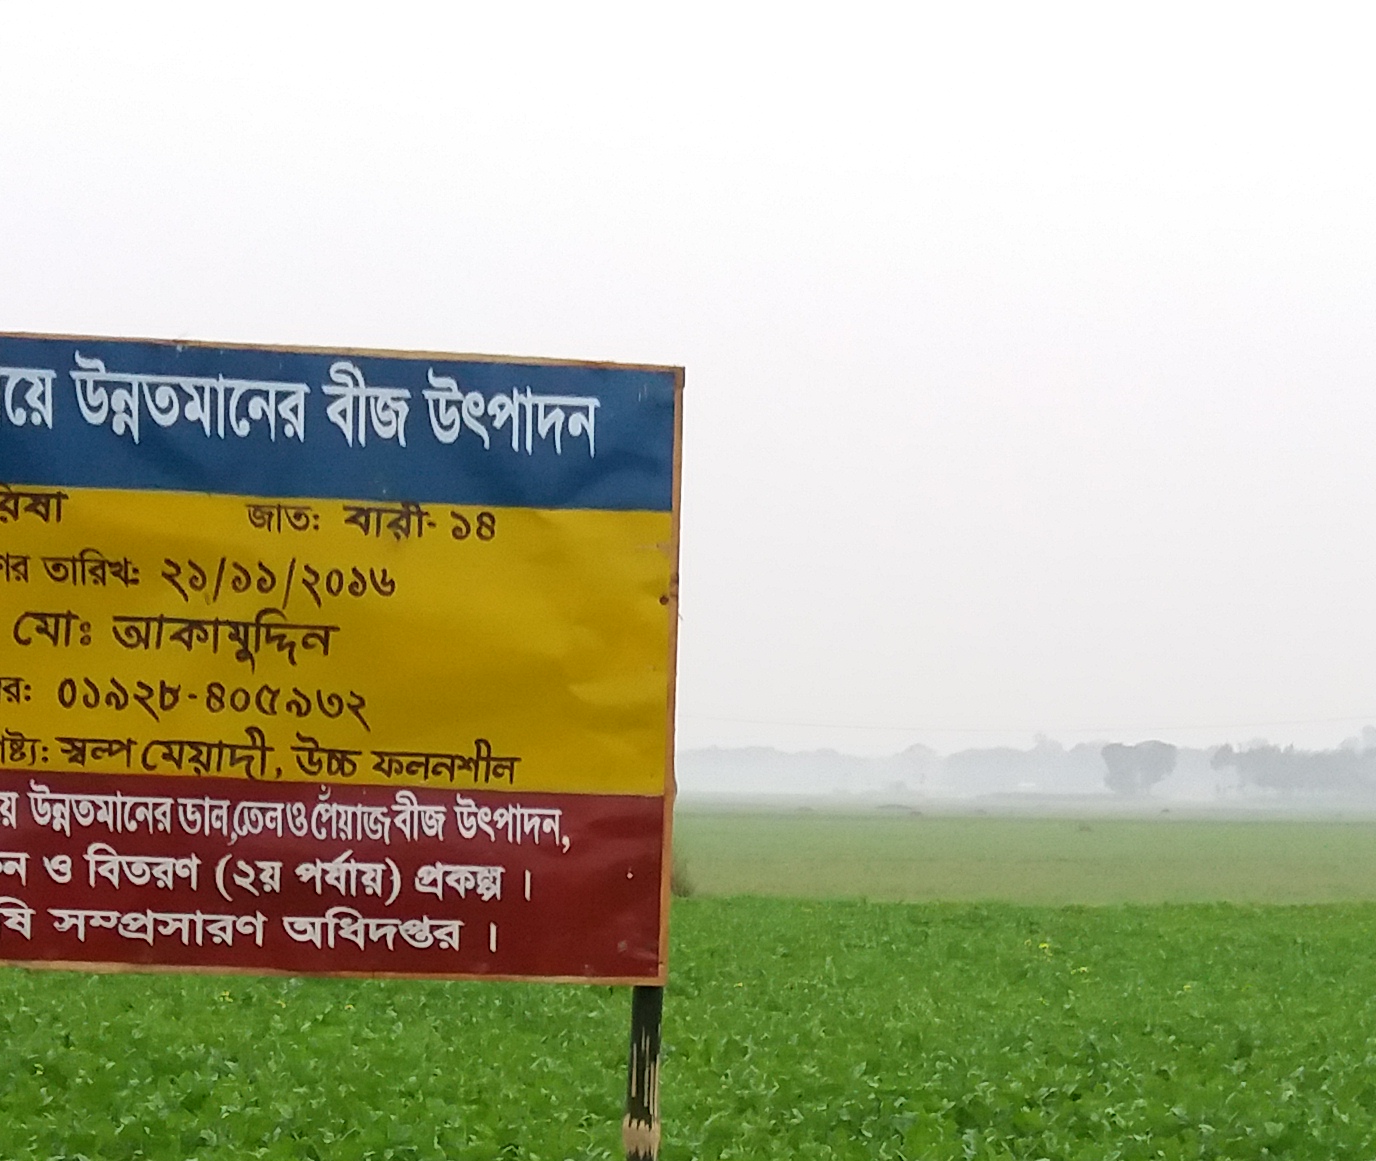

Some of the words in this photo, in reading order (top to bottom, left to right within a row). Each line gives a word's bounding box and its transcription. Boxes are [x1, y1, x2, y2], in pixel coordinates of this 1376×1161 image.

[70, 350, 310, 443] উন্নতমানের
[322, 361, 411, 448] বীজ
[422, 368, 600, 458] উৎপাদন
[451, 511, 496, 541] ১৪
[161, 557, 395, 609] ২১/১১/২০১৬
[58, 676, 370, 732] ০১৯২৮-৪০৫৯৭২
[55, 736, 137, 768] স্বল্প
[290, 731, 361, 776] উচ্চ
[371, 739, 522, 785] ফলনশীল
[27, 779, 174, 837] উন্নতমানের
[43, 855, 73, 883] ও
[84, 843, 202, 891] বিতরণ
[216, 853, 282, 901] (২য়
[415, 861, 506, 901] প্রকল্প
[48, 907, 267, 947] সম্প্রসারণ
[283, 906, 464, 952] অধিদপ্তর
